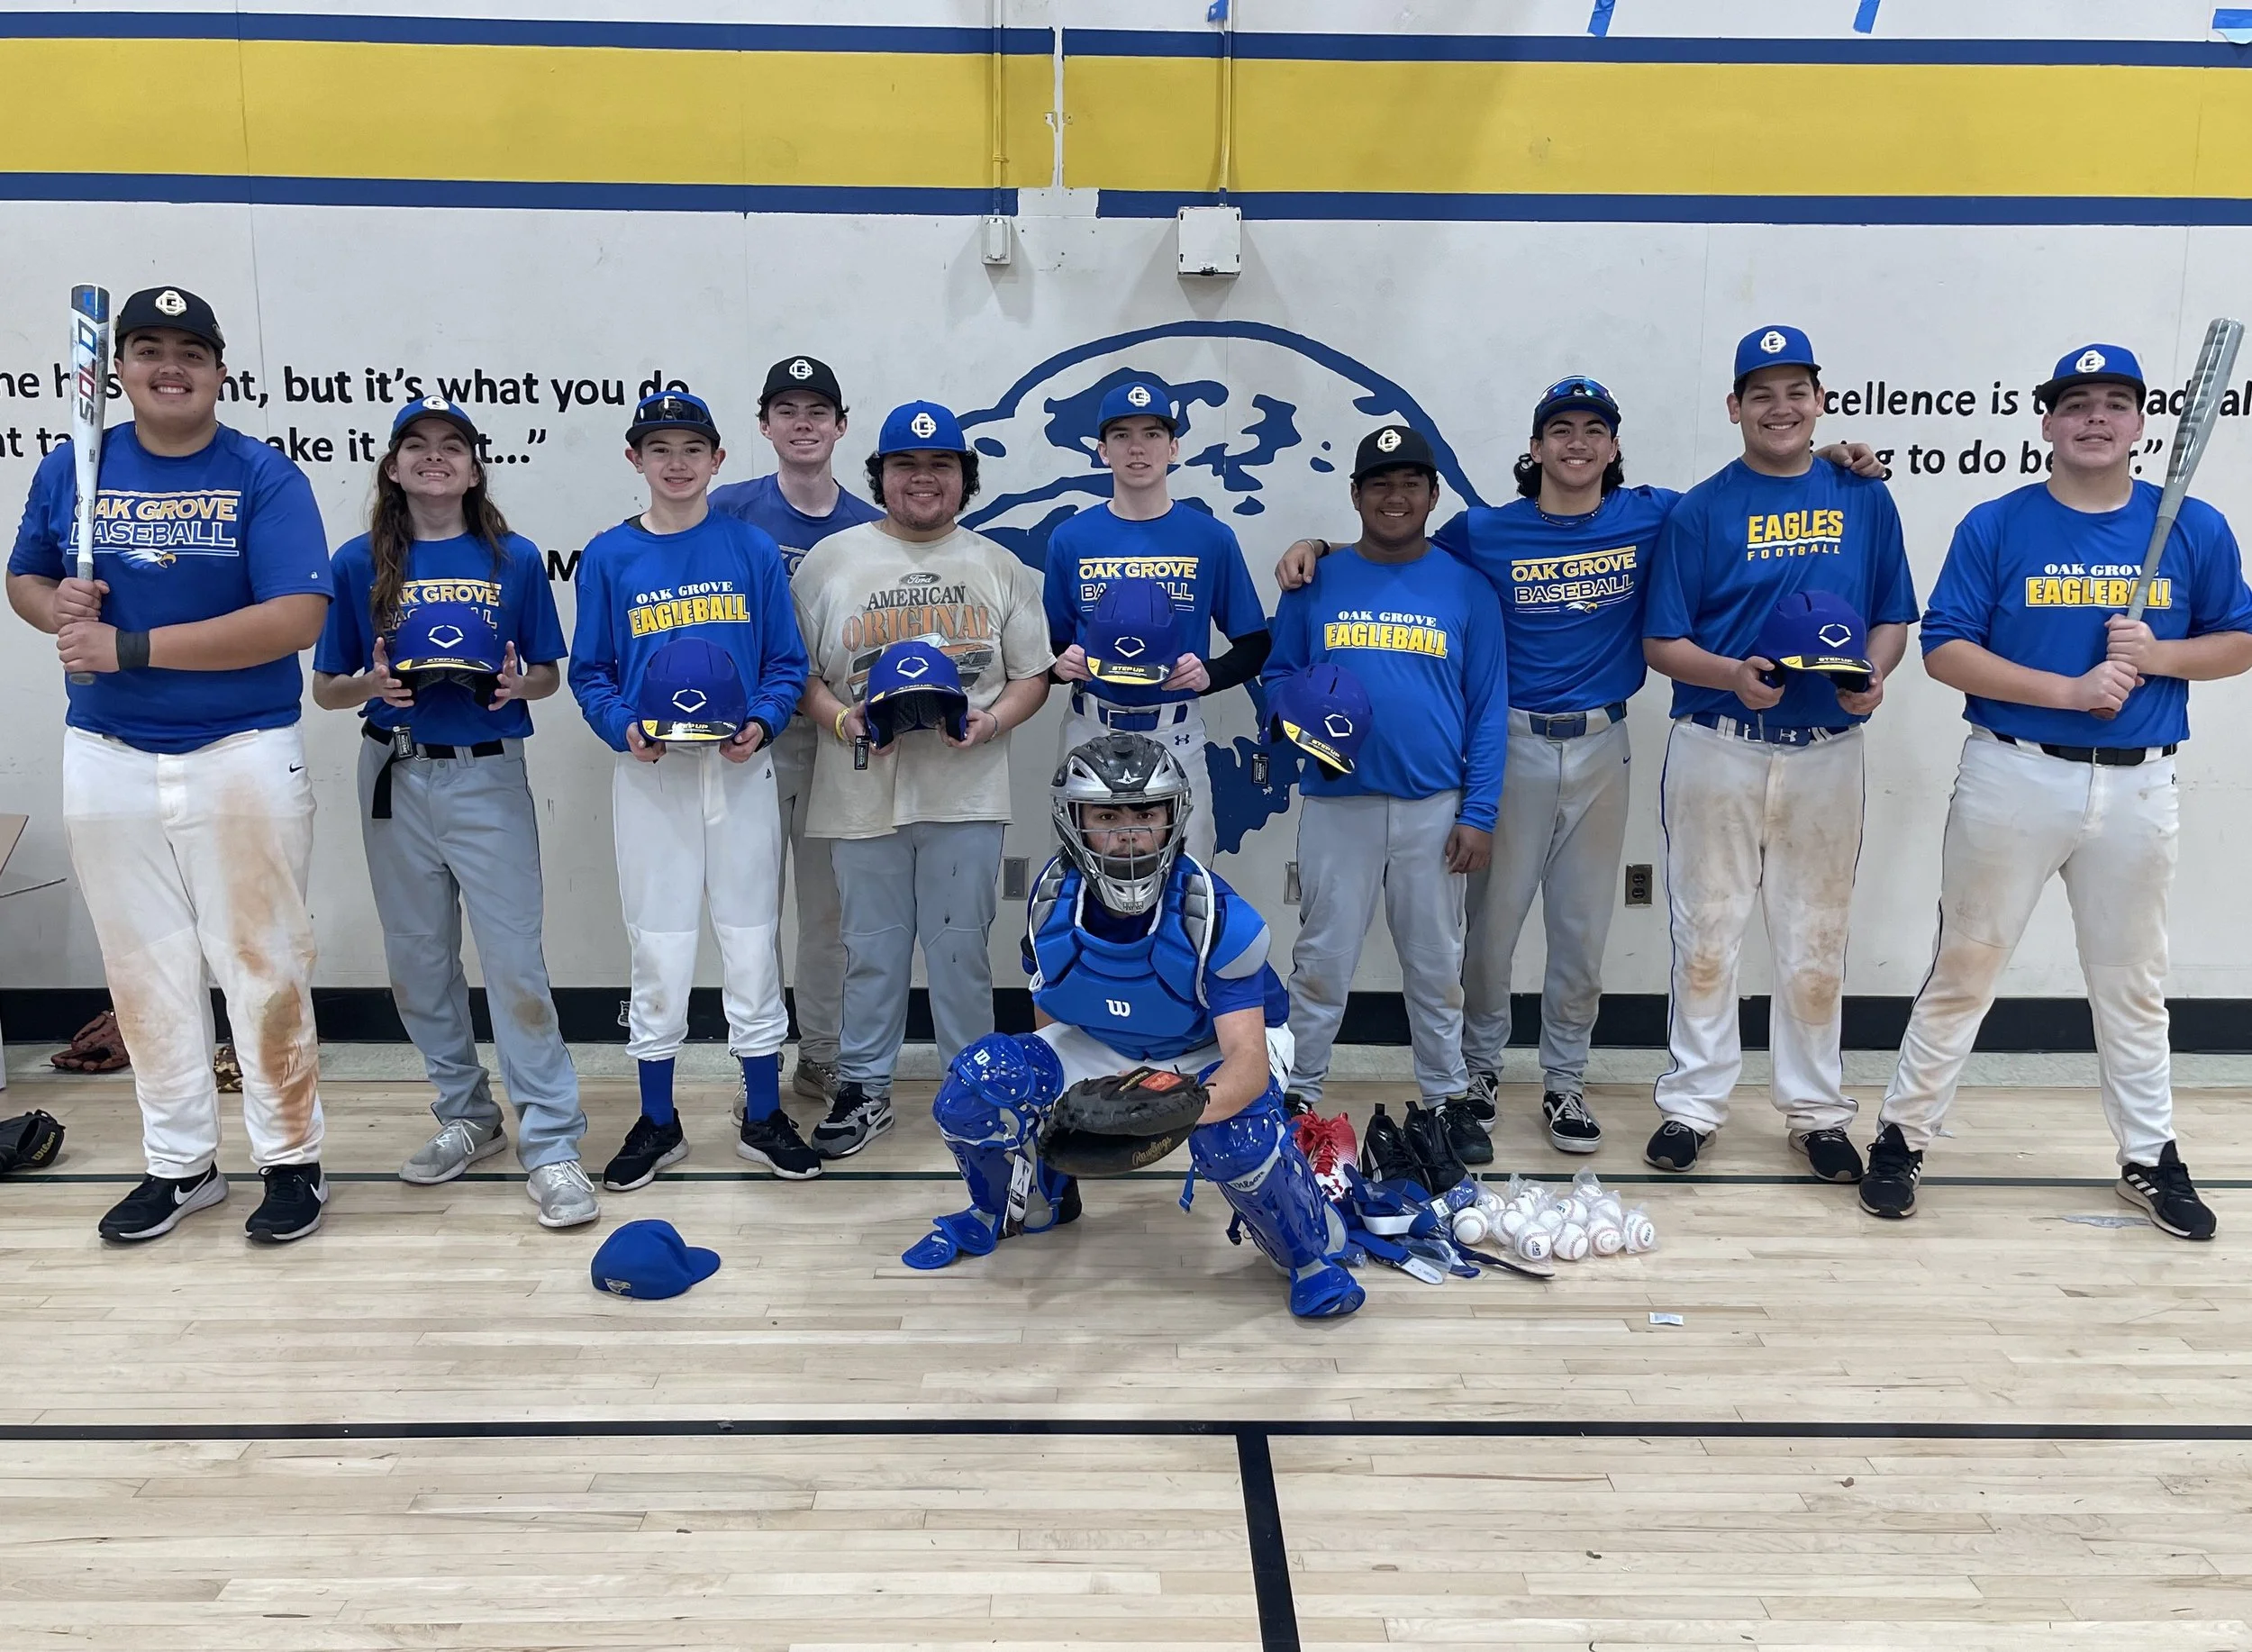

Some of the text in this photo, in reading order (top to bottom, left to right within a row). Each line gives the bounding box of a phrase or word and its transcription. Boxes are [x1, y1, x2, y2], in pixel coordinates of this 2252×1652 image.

[283, 366, 353, 404] but
[437, 368, 540, 404] what
[550, 378, 625, 413] you
[1991, 381, 2020, 415] is
[348, 429, 376, 462] it
[1908, 444, 1946, 474] to
[1958, 440, 2007, 474] do
[136, 498, 239, 522] GROVE
[1748, 509, 1844, 543] EAGLES
[1512, 551, 1637, 583] OAK GROVE
[1748, 543, 1840, 561] FOOTBALL
[907, 574, 933, 585] Ford
[1079, 562, 1197, 579] OAK GROVE
[2044, 563, 2085, 576] OAK
[422, 585, 501, 607] GROVE
[636, 581, 733, 604] OAK GROVE
[867, 585, 966, 612] AMERICAN
[1514, 574, 1635, 604] BASEBALL
[628, 594, 749, 639] EAGLEBALL
[842, 604, 992, 653] ORIGINAL
[1338, 611, 1437, 628] OAK GROVE
[1324, 622, 1448, 659] EAGLEBALL
[32, 1131, 56, 1161] Wilson
